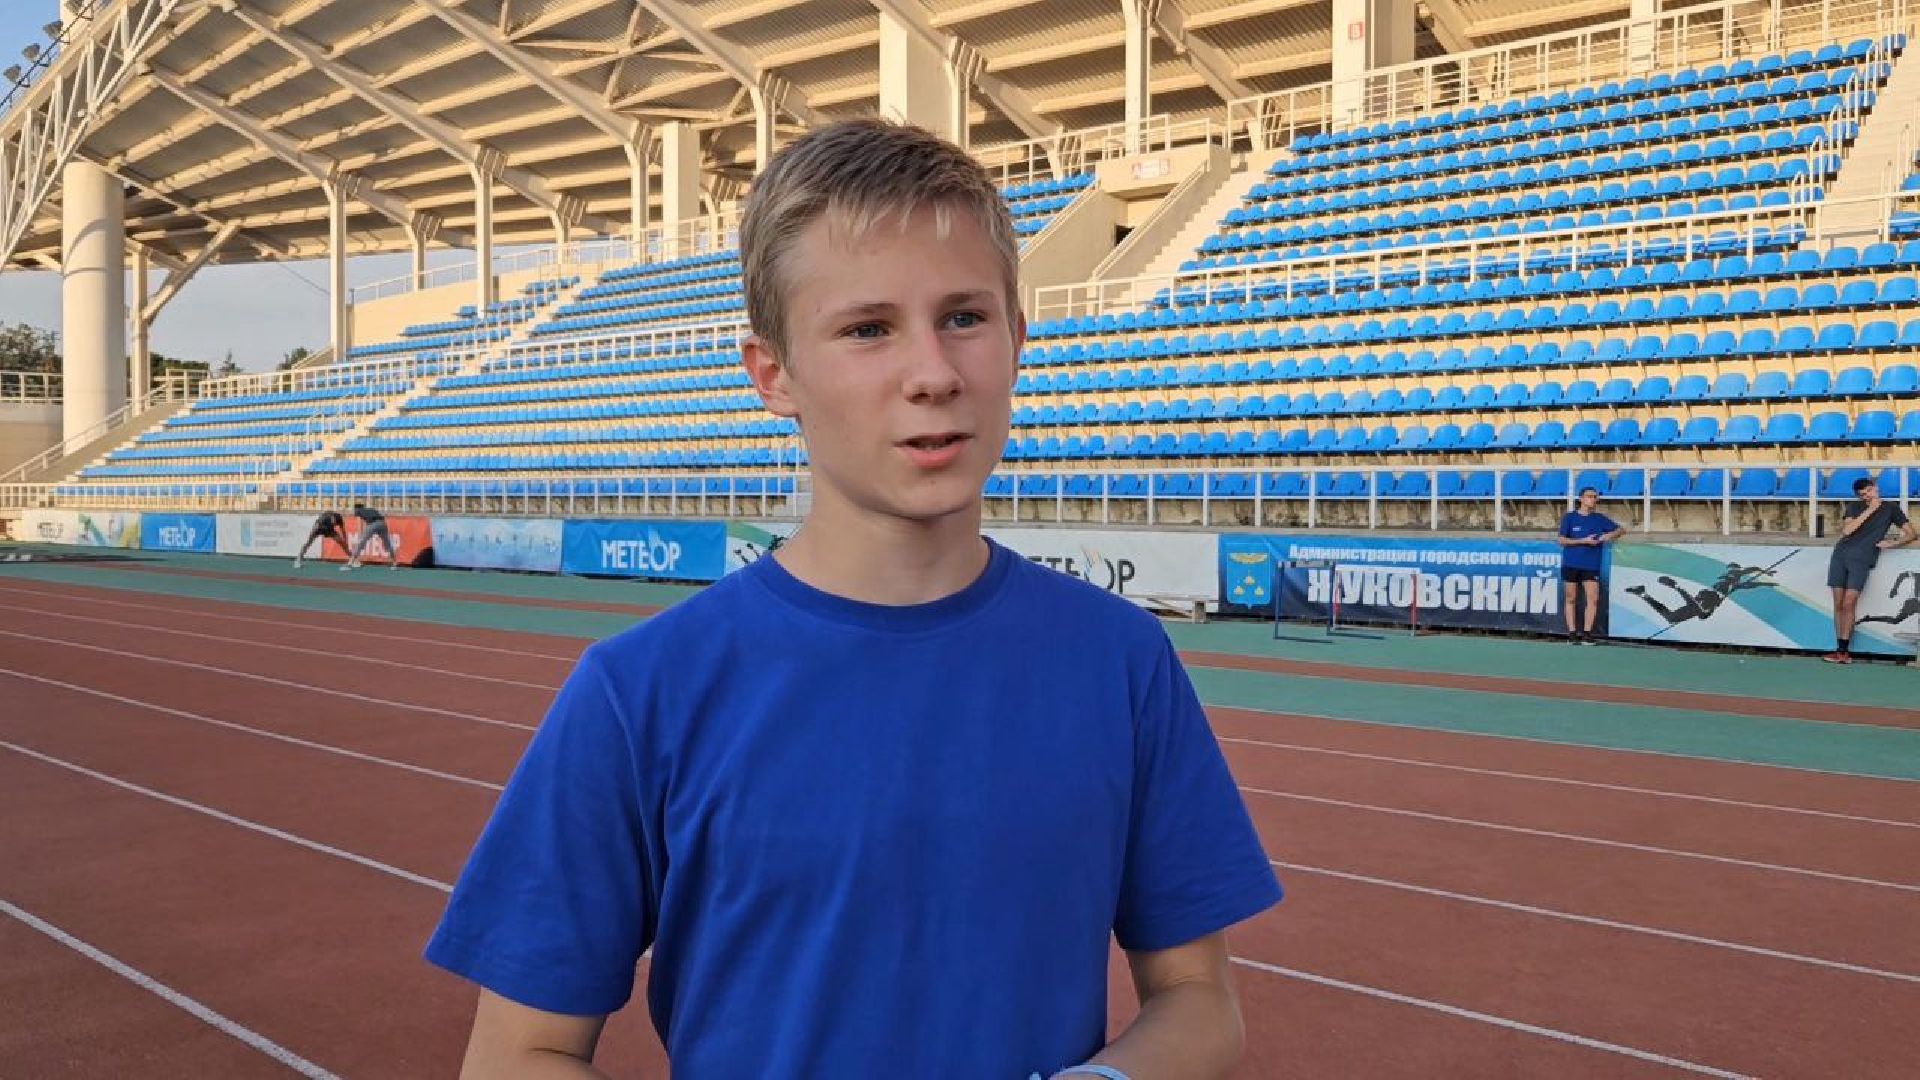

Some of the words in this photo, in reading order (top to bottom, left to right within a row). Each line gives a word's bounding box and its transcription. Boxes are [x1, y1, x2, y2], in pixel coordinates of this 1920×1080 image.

[600, 540, 682, 571] МЕТЕОР
[1288, 543, 1418, 564] Администрация
[1420, 549, 1519, 566] городского
[1522, 552, 1561, 568] окру
[1307, 569, 1558, 614] ЖУКОВСКИЙ
